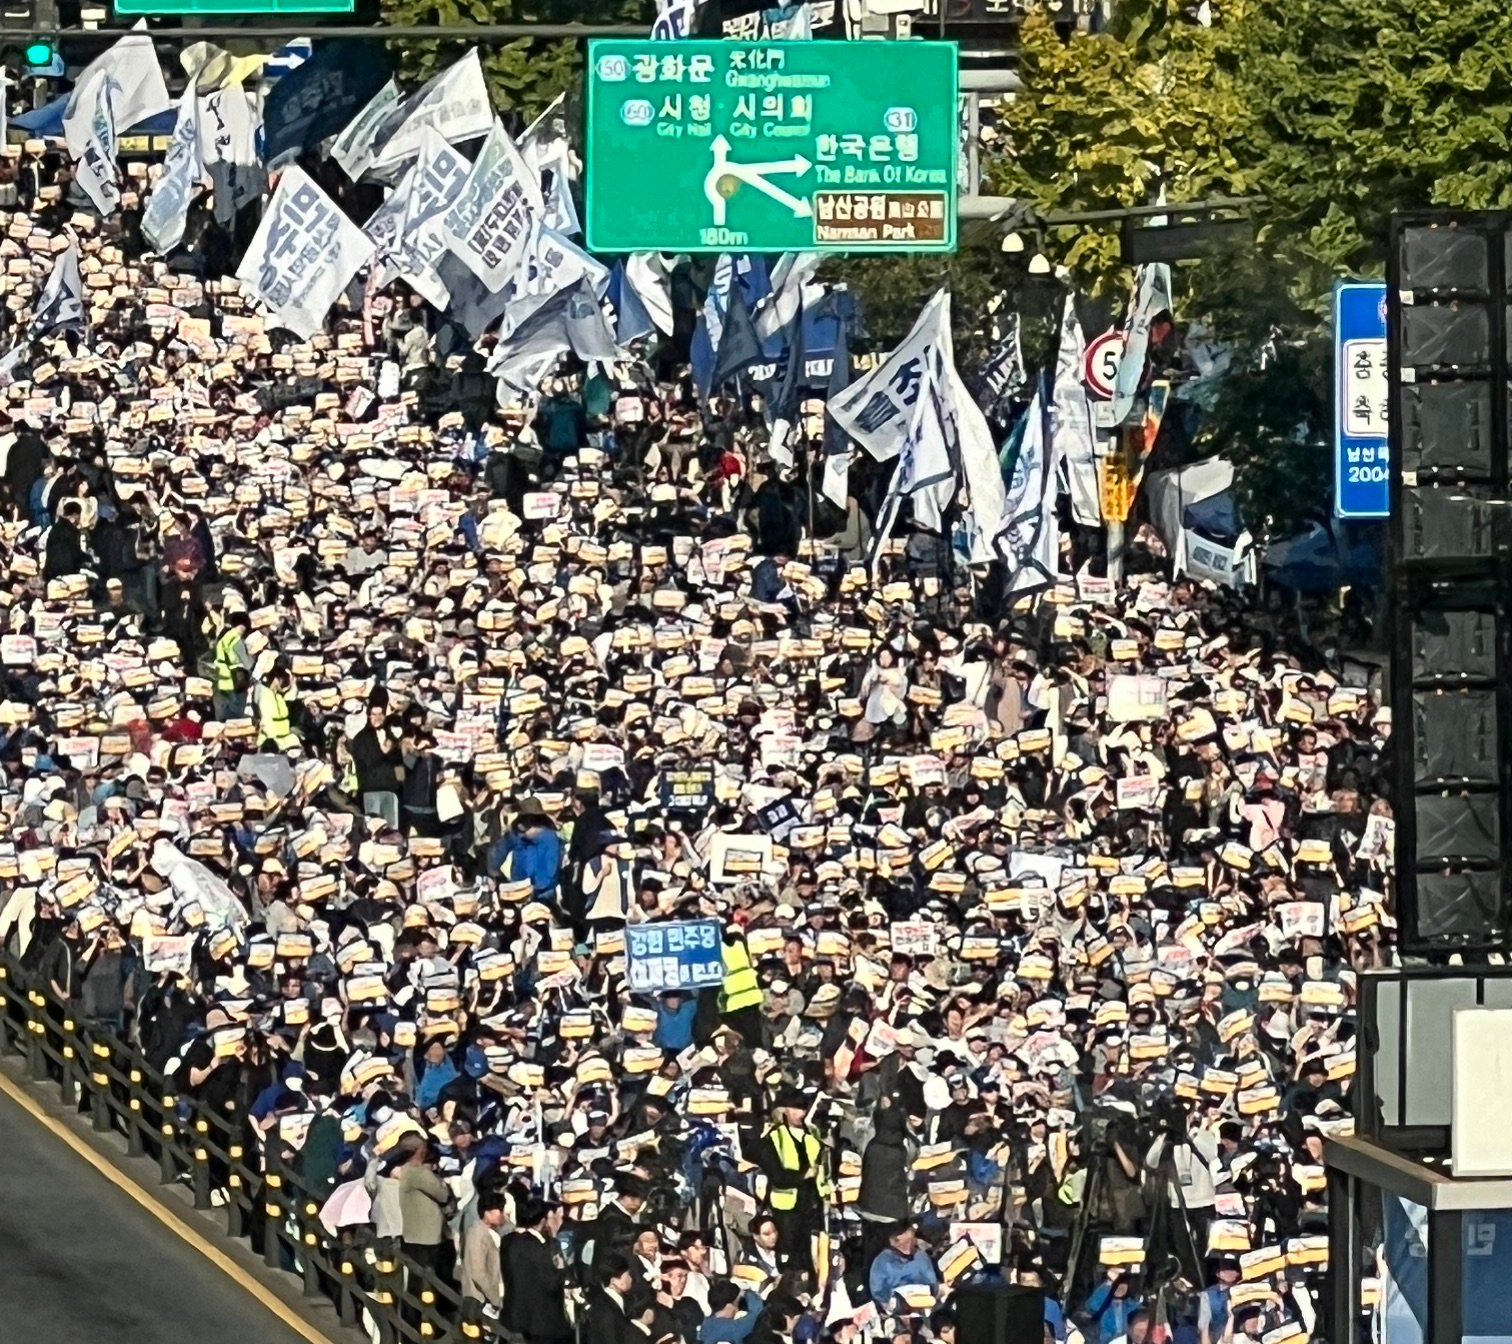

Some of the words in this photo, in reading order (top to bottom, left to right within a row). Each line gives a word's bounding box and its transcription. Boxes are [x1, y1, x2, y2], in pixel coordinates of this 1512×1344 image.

[632, 53, 716, 83] 광화문
[658, 92, 711, 121] 시청
[732, 92, 813, 121] 시의회
[815, 132, 919, 162] 한국은행
[815, 164, 841, 184] The
[844, 165, 881, 184] Bank
[905, 165, 948, 184] Korea
[817, 194, 886, 221] 남산공원
[699, 227, 749, 246] 180m
[882, 223, 917, 240] Park
